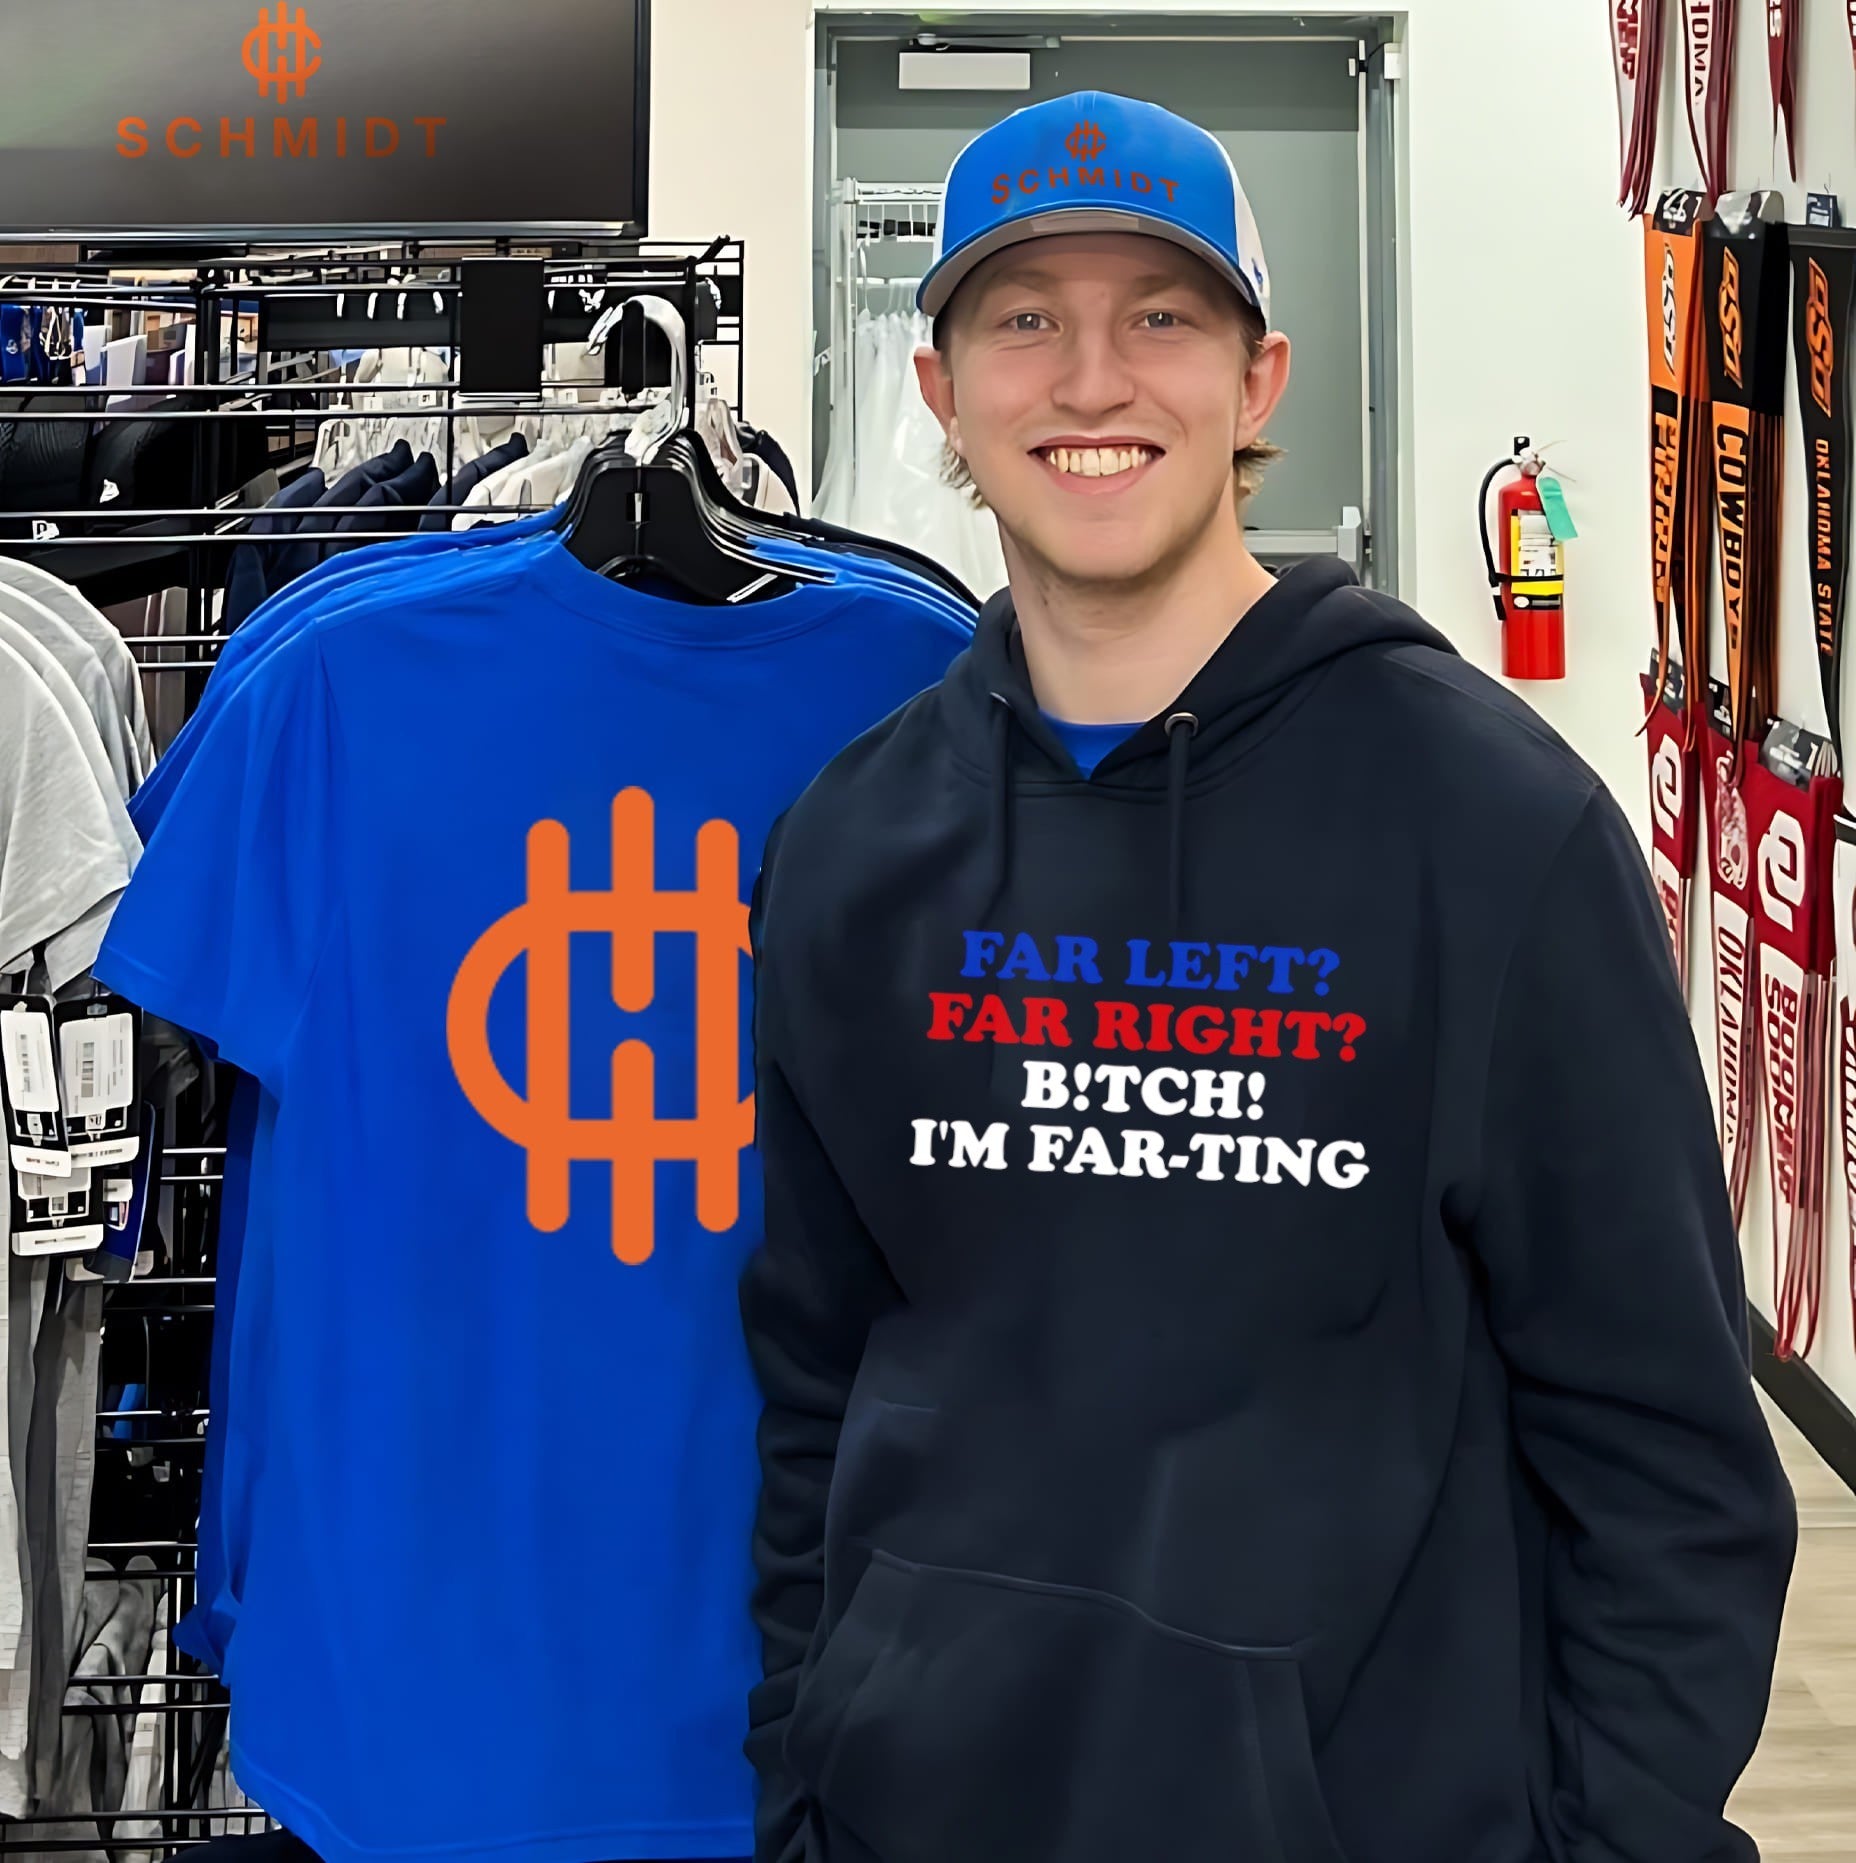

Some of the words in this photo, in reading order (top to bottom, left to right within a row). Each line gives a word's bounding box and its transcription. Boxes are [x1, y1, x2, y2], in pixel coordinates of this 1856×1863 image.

[116, 117, 448, 159] SCHMIDT
[990, 166, 1180, 206] SCHMIDT
[960, 930, 1104, 984] FAR
[1125, 939, 1341, 997] LEFT?
[927, 992, 1073, 1047] FAR
[1093, 1000, 1368, 1062] RIGHT?
[1021, 1060, 1266, 1121] B!TCH!
[909, 1118, 1010, 1170] I'M
[1027, 1124, 1370, 1189] FAR-TING
